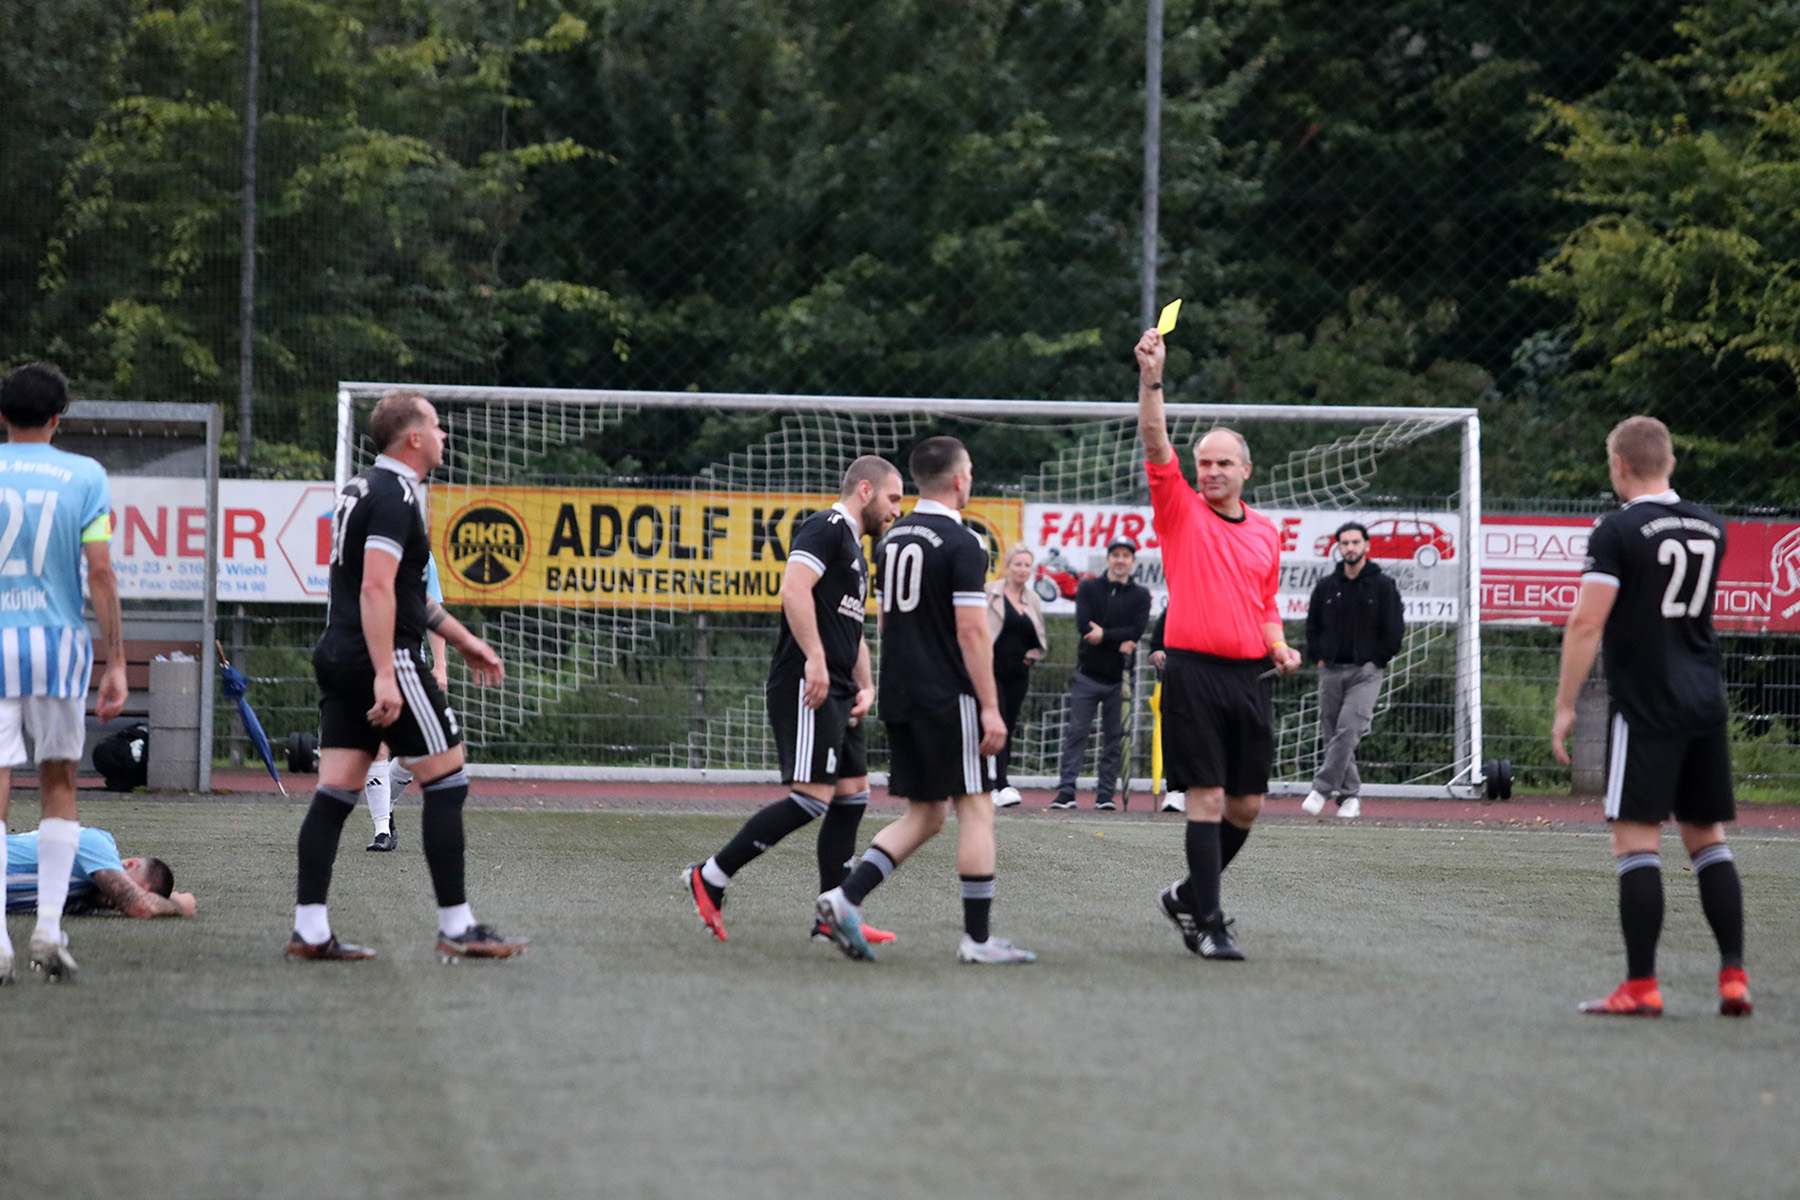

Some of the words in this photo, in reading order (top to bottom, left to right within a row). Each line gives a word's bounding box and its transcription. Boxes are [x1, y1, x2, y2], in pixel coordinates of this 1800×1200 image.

[0, 487, 58, 577] 27
[458, 522, 516, 544] AKA
[548, 503, 730, 560] ADOLF
[1038, 511, 1161, 551] FAHR
[226, 563, 268, 576] Wiehl
[547, 566, 782, 597] BAUUNTERNEHMU
[883, 542, 924, 613] 10
[1657, 538, 1716, 618] 27
[1480, 583, 1582, 608] TELEKO
[1714, 589, 1772, 612] TION
